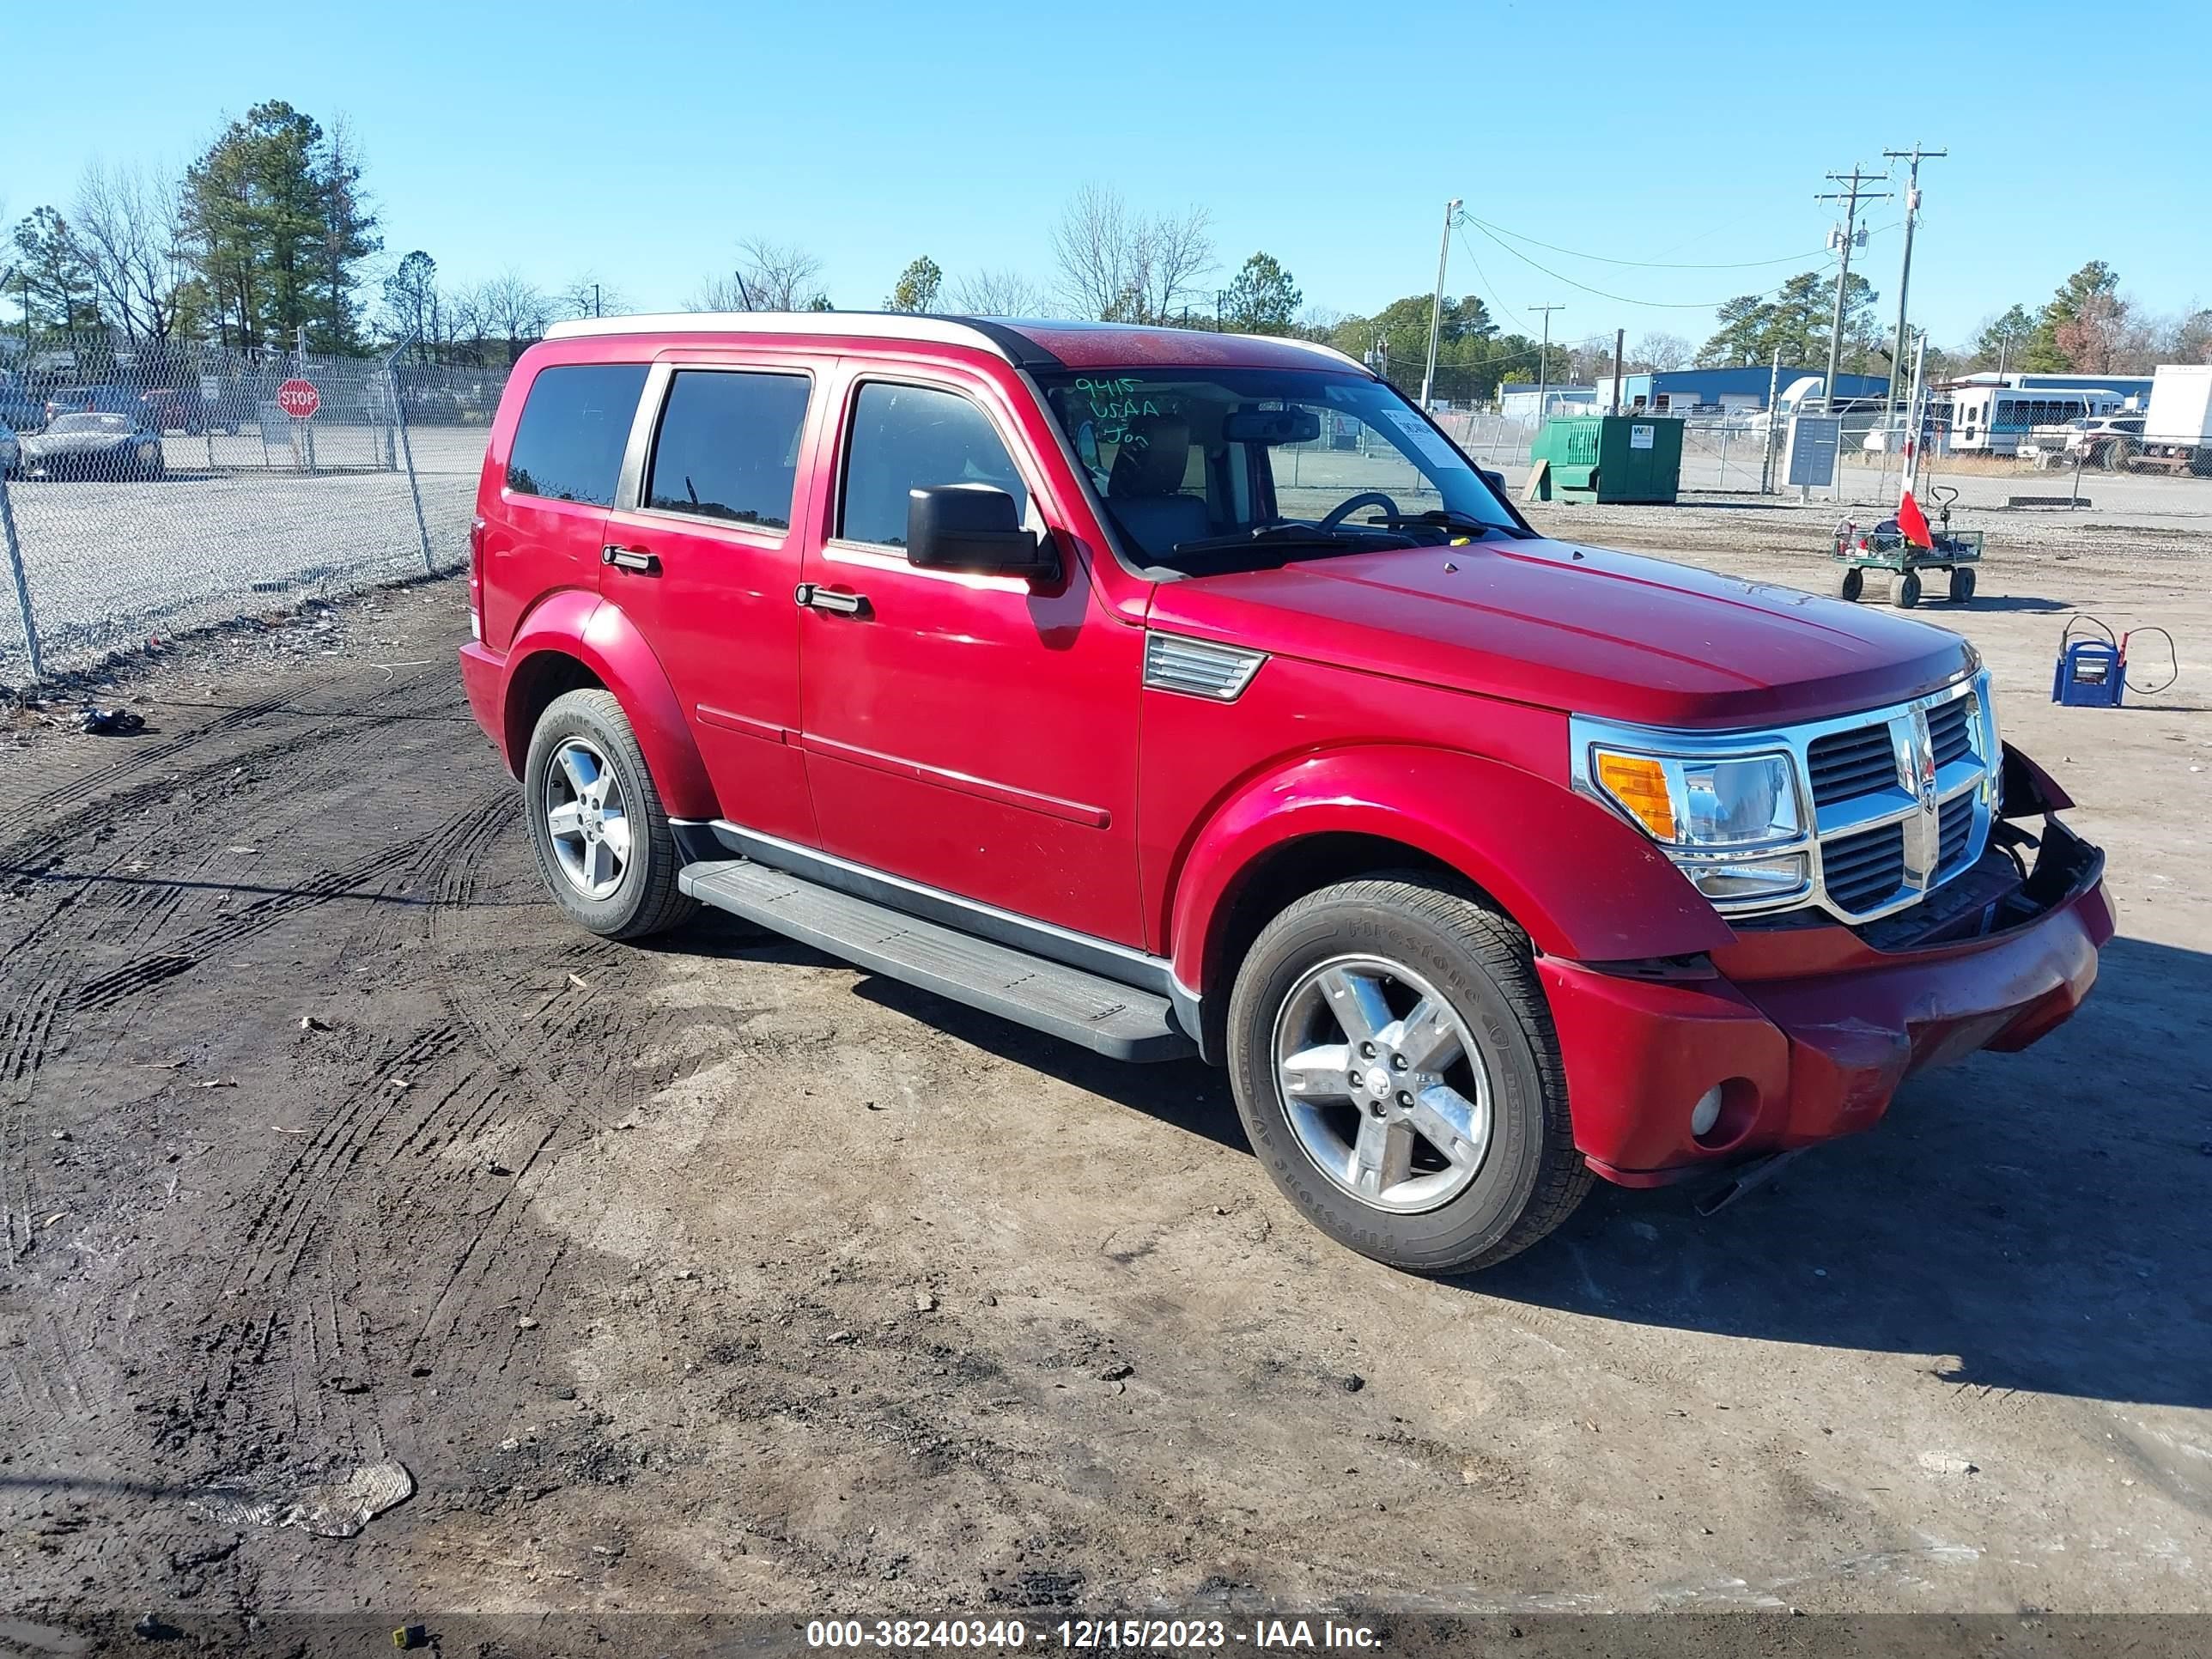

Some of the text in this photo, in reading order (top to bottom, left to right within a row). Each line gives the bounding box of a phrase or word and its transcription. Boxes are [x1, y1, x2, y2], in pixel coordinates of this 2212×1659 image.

[1074, 378, 1144, 398] 9415
[282, 391, 316, 405] STOP
[1089, 399, 1160, 418] USAA
[1346, 917, 1481, 1006] Firestone
